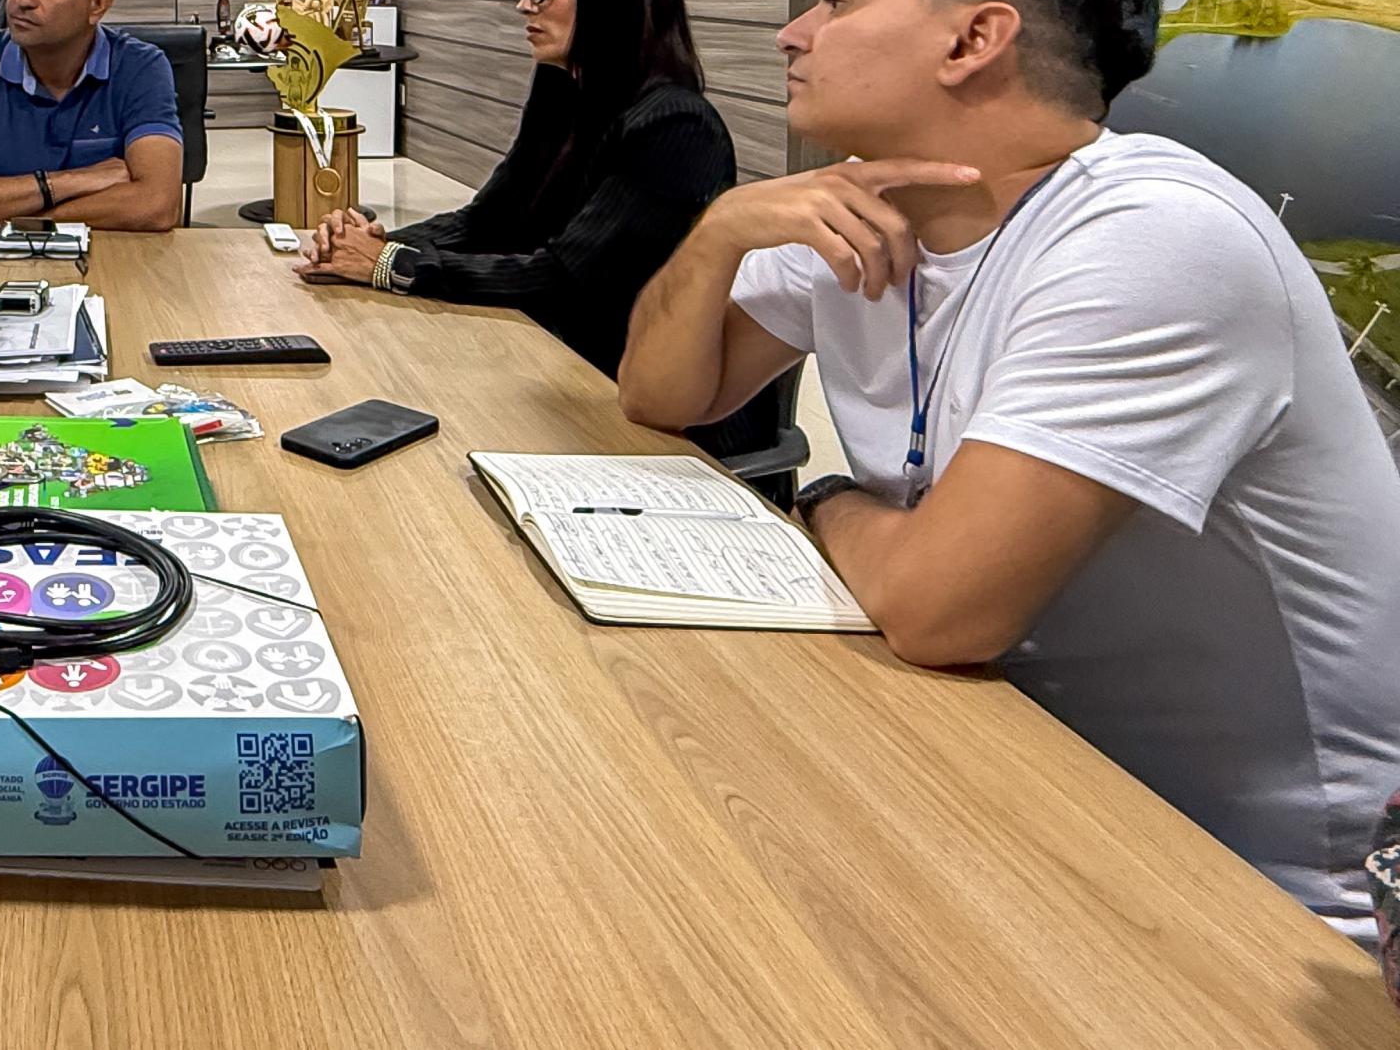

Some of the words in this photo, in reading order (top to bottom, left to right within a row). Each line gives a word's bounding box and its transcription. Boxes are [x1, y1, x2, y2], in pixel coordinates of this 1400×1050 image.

[86, 775, 206, 798] SERGIPE
[142, 799, 159, 809] DO
[161, 799, 206, 809] ESTADO
[224, 821, 269, 831] ACESSE
[271, 821, 281, 831] A
[283, 816, 331, 830] REVISTA
[227, 833, 269, 842] SEASIC
[285, 828, 329, 843] EDIÇÃO
